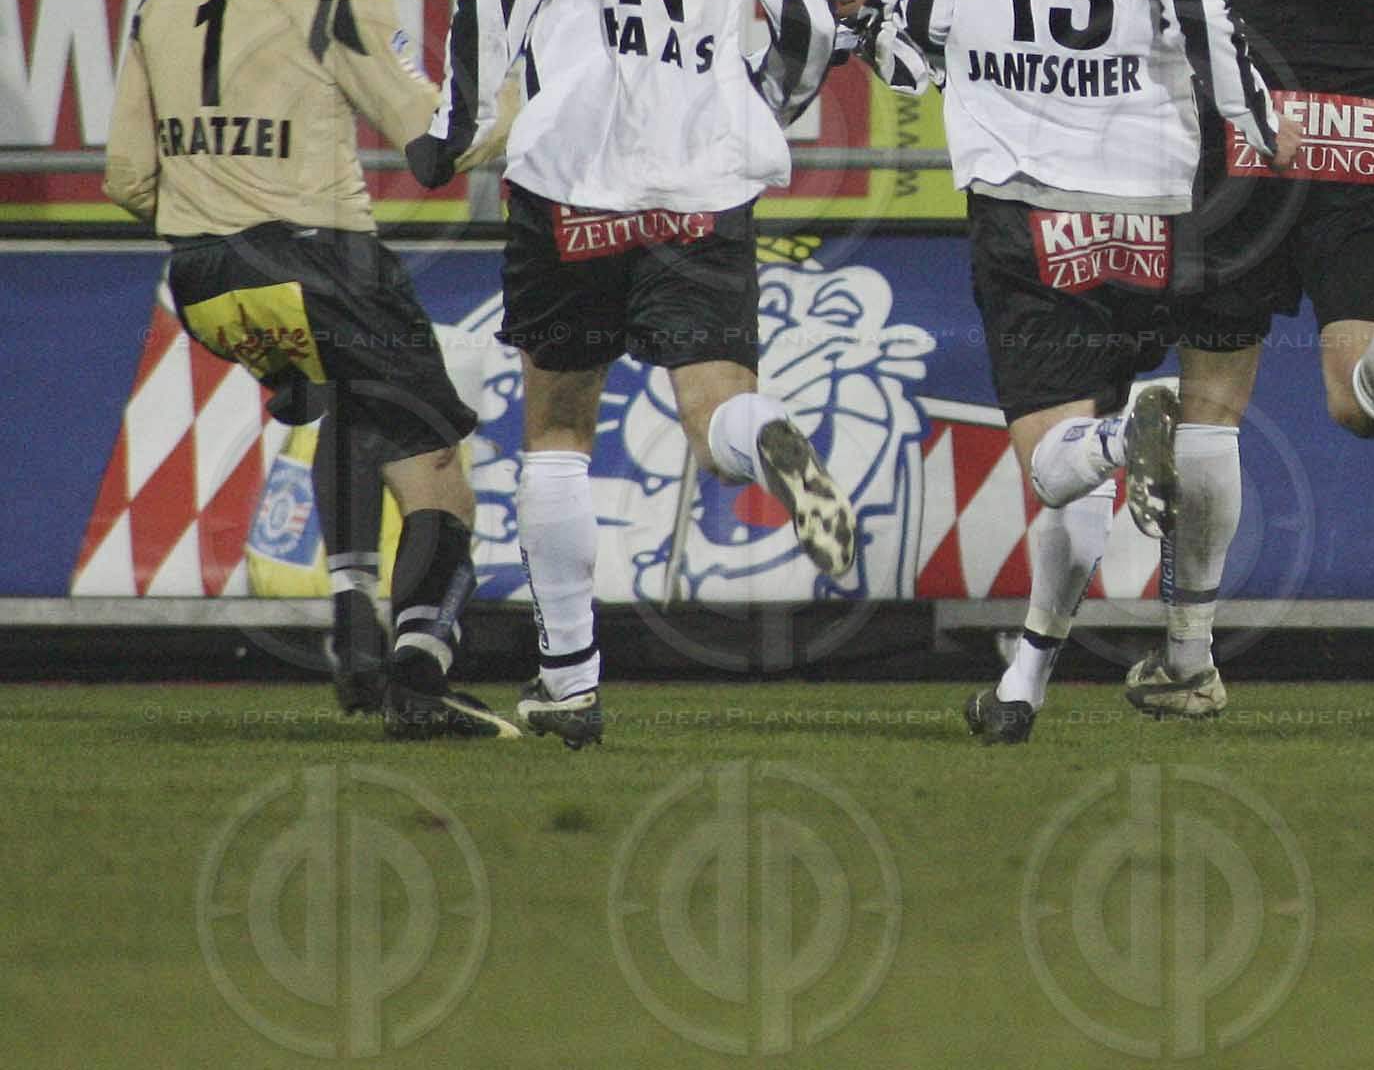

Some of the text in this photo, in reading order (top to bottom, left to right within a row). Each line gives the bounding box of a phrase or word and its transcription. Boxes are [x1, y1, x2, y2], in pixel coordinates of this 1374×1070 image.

[968, 50, 1143, 99] JANTSCHER
[563, 212, 705, 253] ZEITUNG
[1041, 212, 1166, 255] KLEINE
[1048, 250, 1168, 289] ZEITUNG
